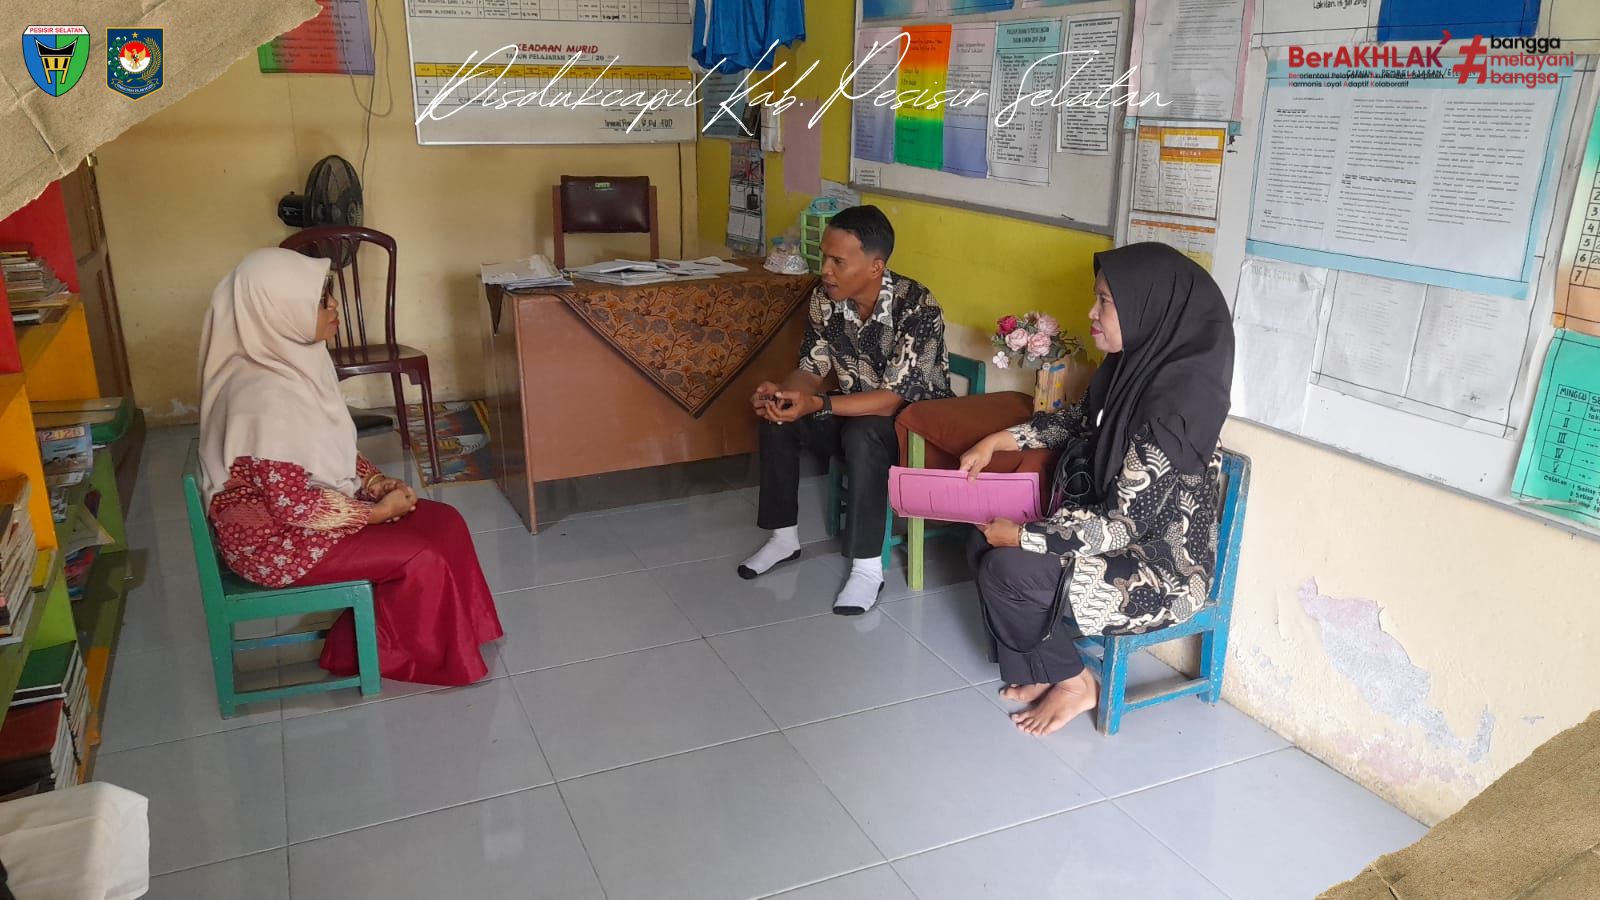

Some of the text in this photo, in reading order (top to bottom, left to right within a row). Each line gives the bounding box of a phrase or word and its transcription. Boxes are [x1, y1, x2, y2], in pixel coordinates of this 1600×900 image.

[514, 43, 599, 54] KEADAAN MURID
[1591, 207, 1598, 216] 3
[1587, 223, 1594, 233] 4
[1583, 238, 1591, 247] 5
[1579, 254, 1586, 263] 6
